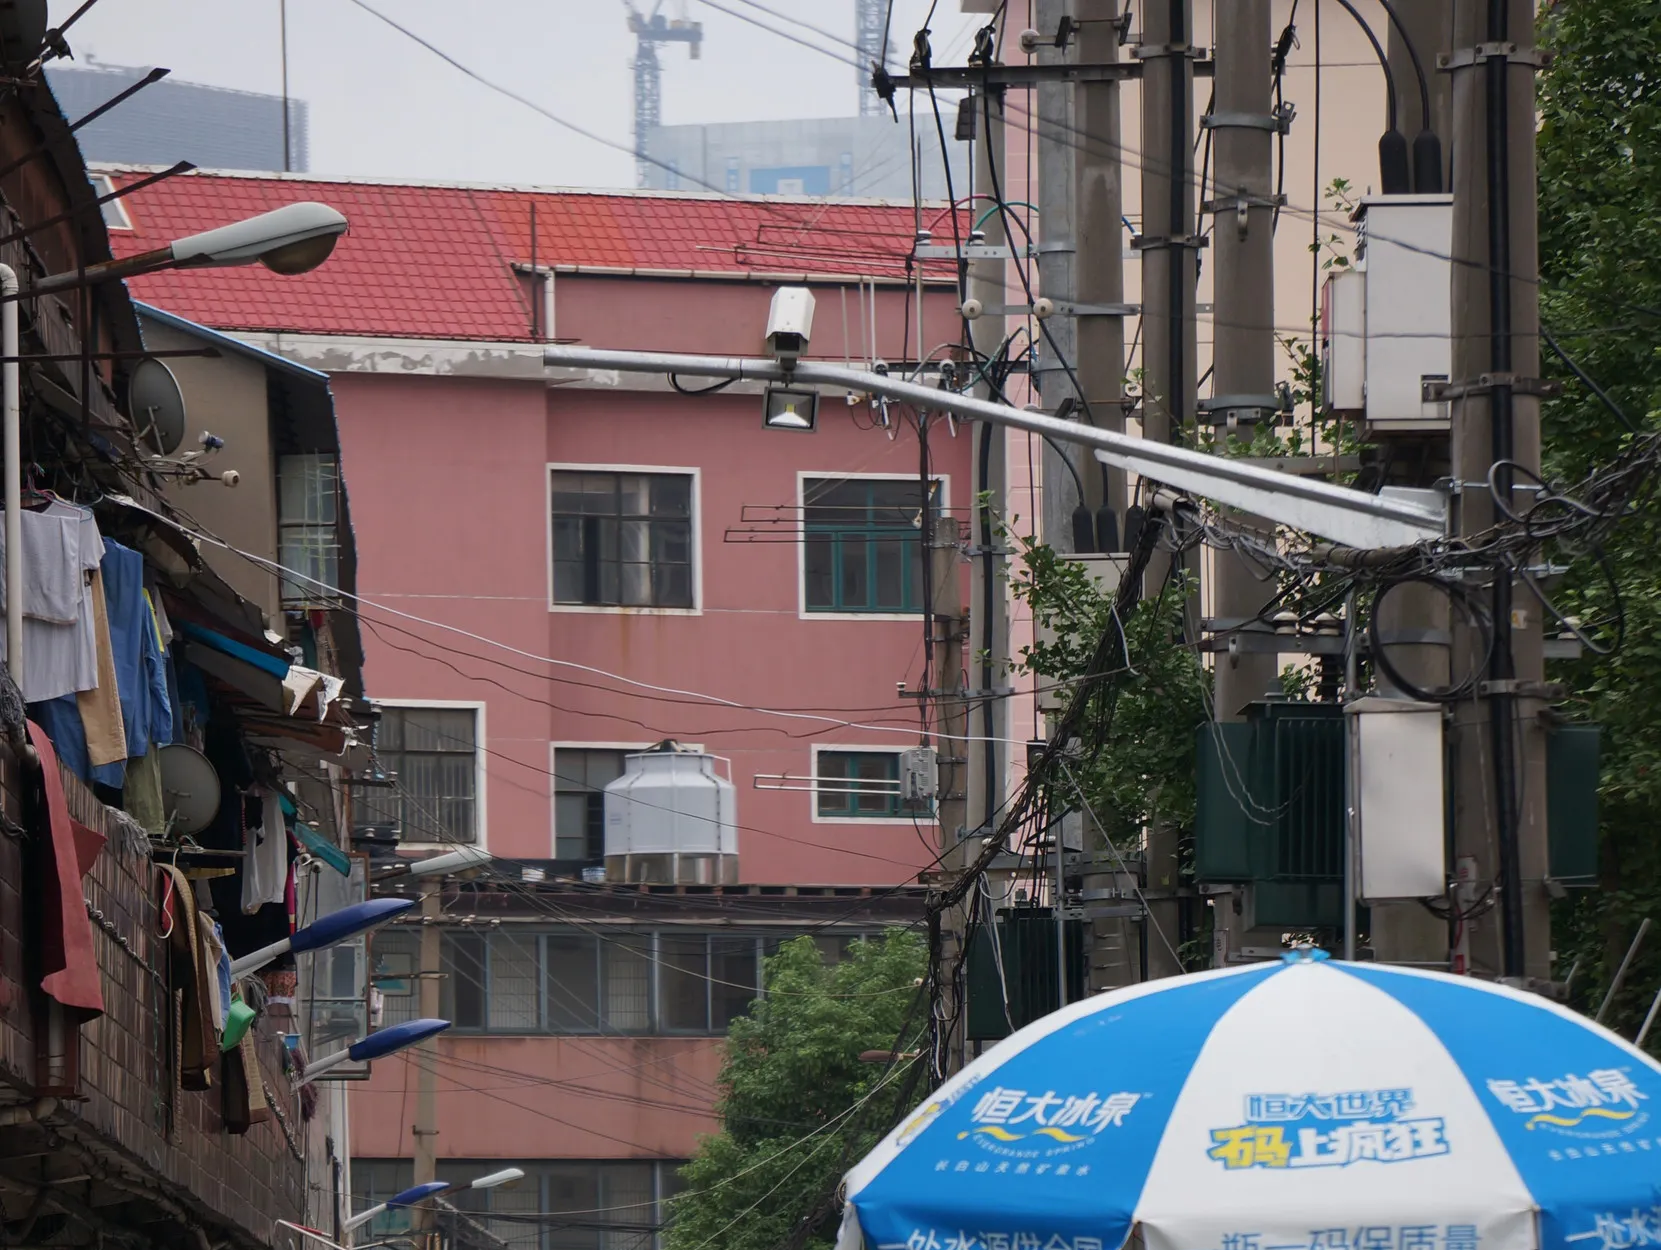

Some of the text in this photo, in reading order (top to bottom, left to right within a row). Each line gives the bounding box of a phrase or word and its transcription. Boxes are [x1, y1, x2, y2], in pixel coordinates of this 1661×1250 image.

[971, 1086, 1141, 1134] 恒大冰泉
[1244, 1087, 1416, 1122] 恒大世界
[1486, 1069, 1649, 1113] 恒大冰泉
[1207, 1117, 1450, 1169] 码上疯狂
